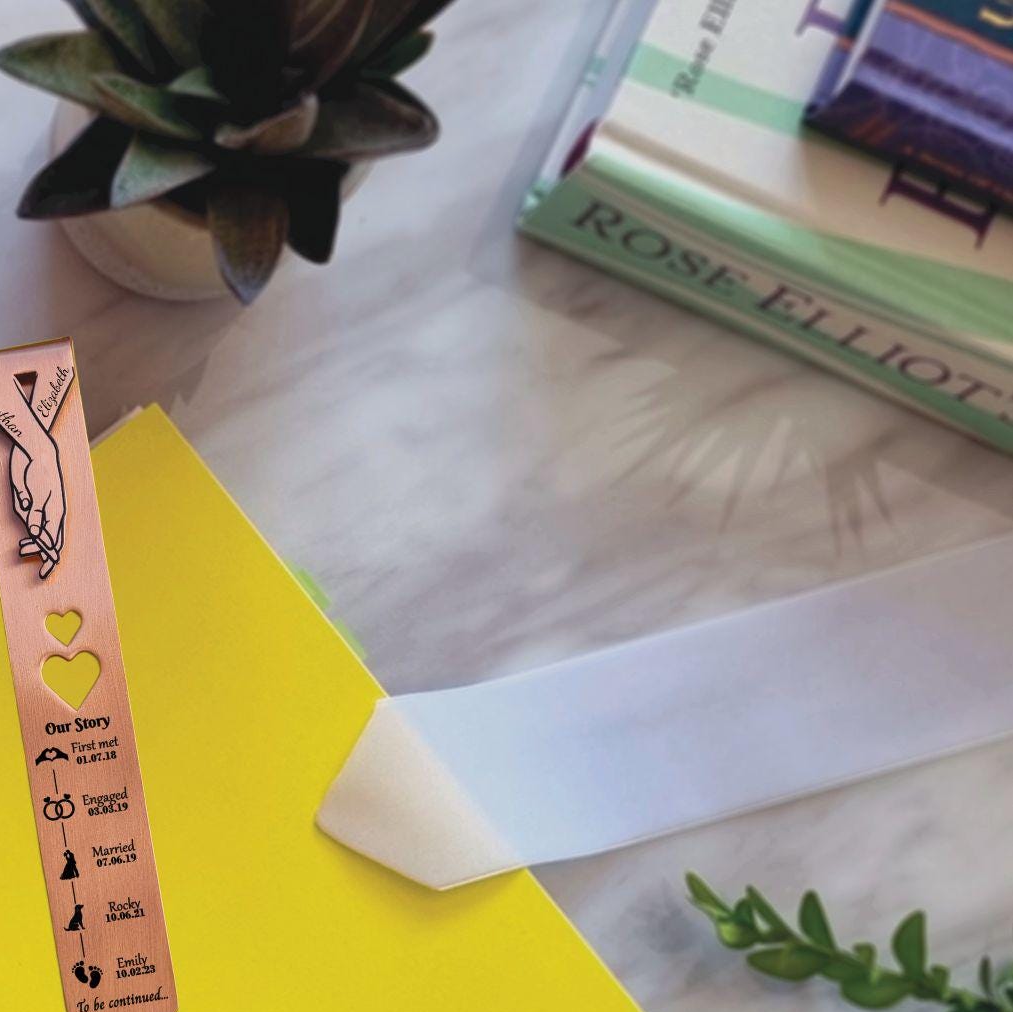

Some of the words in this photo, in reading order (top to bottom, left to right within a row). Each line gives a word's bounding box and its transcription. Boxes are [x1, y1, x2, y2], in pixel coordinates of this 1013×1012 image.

[571, 202, 748, 299] ROSE
[36, 366, 69, 418] Elizabeth
[45, 722, 72, 735] Our
[75, 716, 110, 733] Story
[71, 740, 96, 753] First
[98, 736, 119, 750] met
[76, 751, 117, 765] 01.07.18
[82, 786, 129, 808] Engaged
[88, 802, 129, 817] 03.03.19
[92, 839, 136, 858] Married
[96, 853, 137, 868] 07.06.19
[108, 897, 141, 914] Rocky
[105, 908, 145, 923] 10.06.21
[116, 953, 148, 969] Emily
[116, 964, 156, 979] 10.02.23
[94, 997, 105, 1011] be
[109, 986, 169, 1009] continued...
